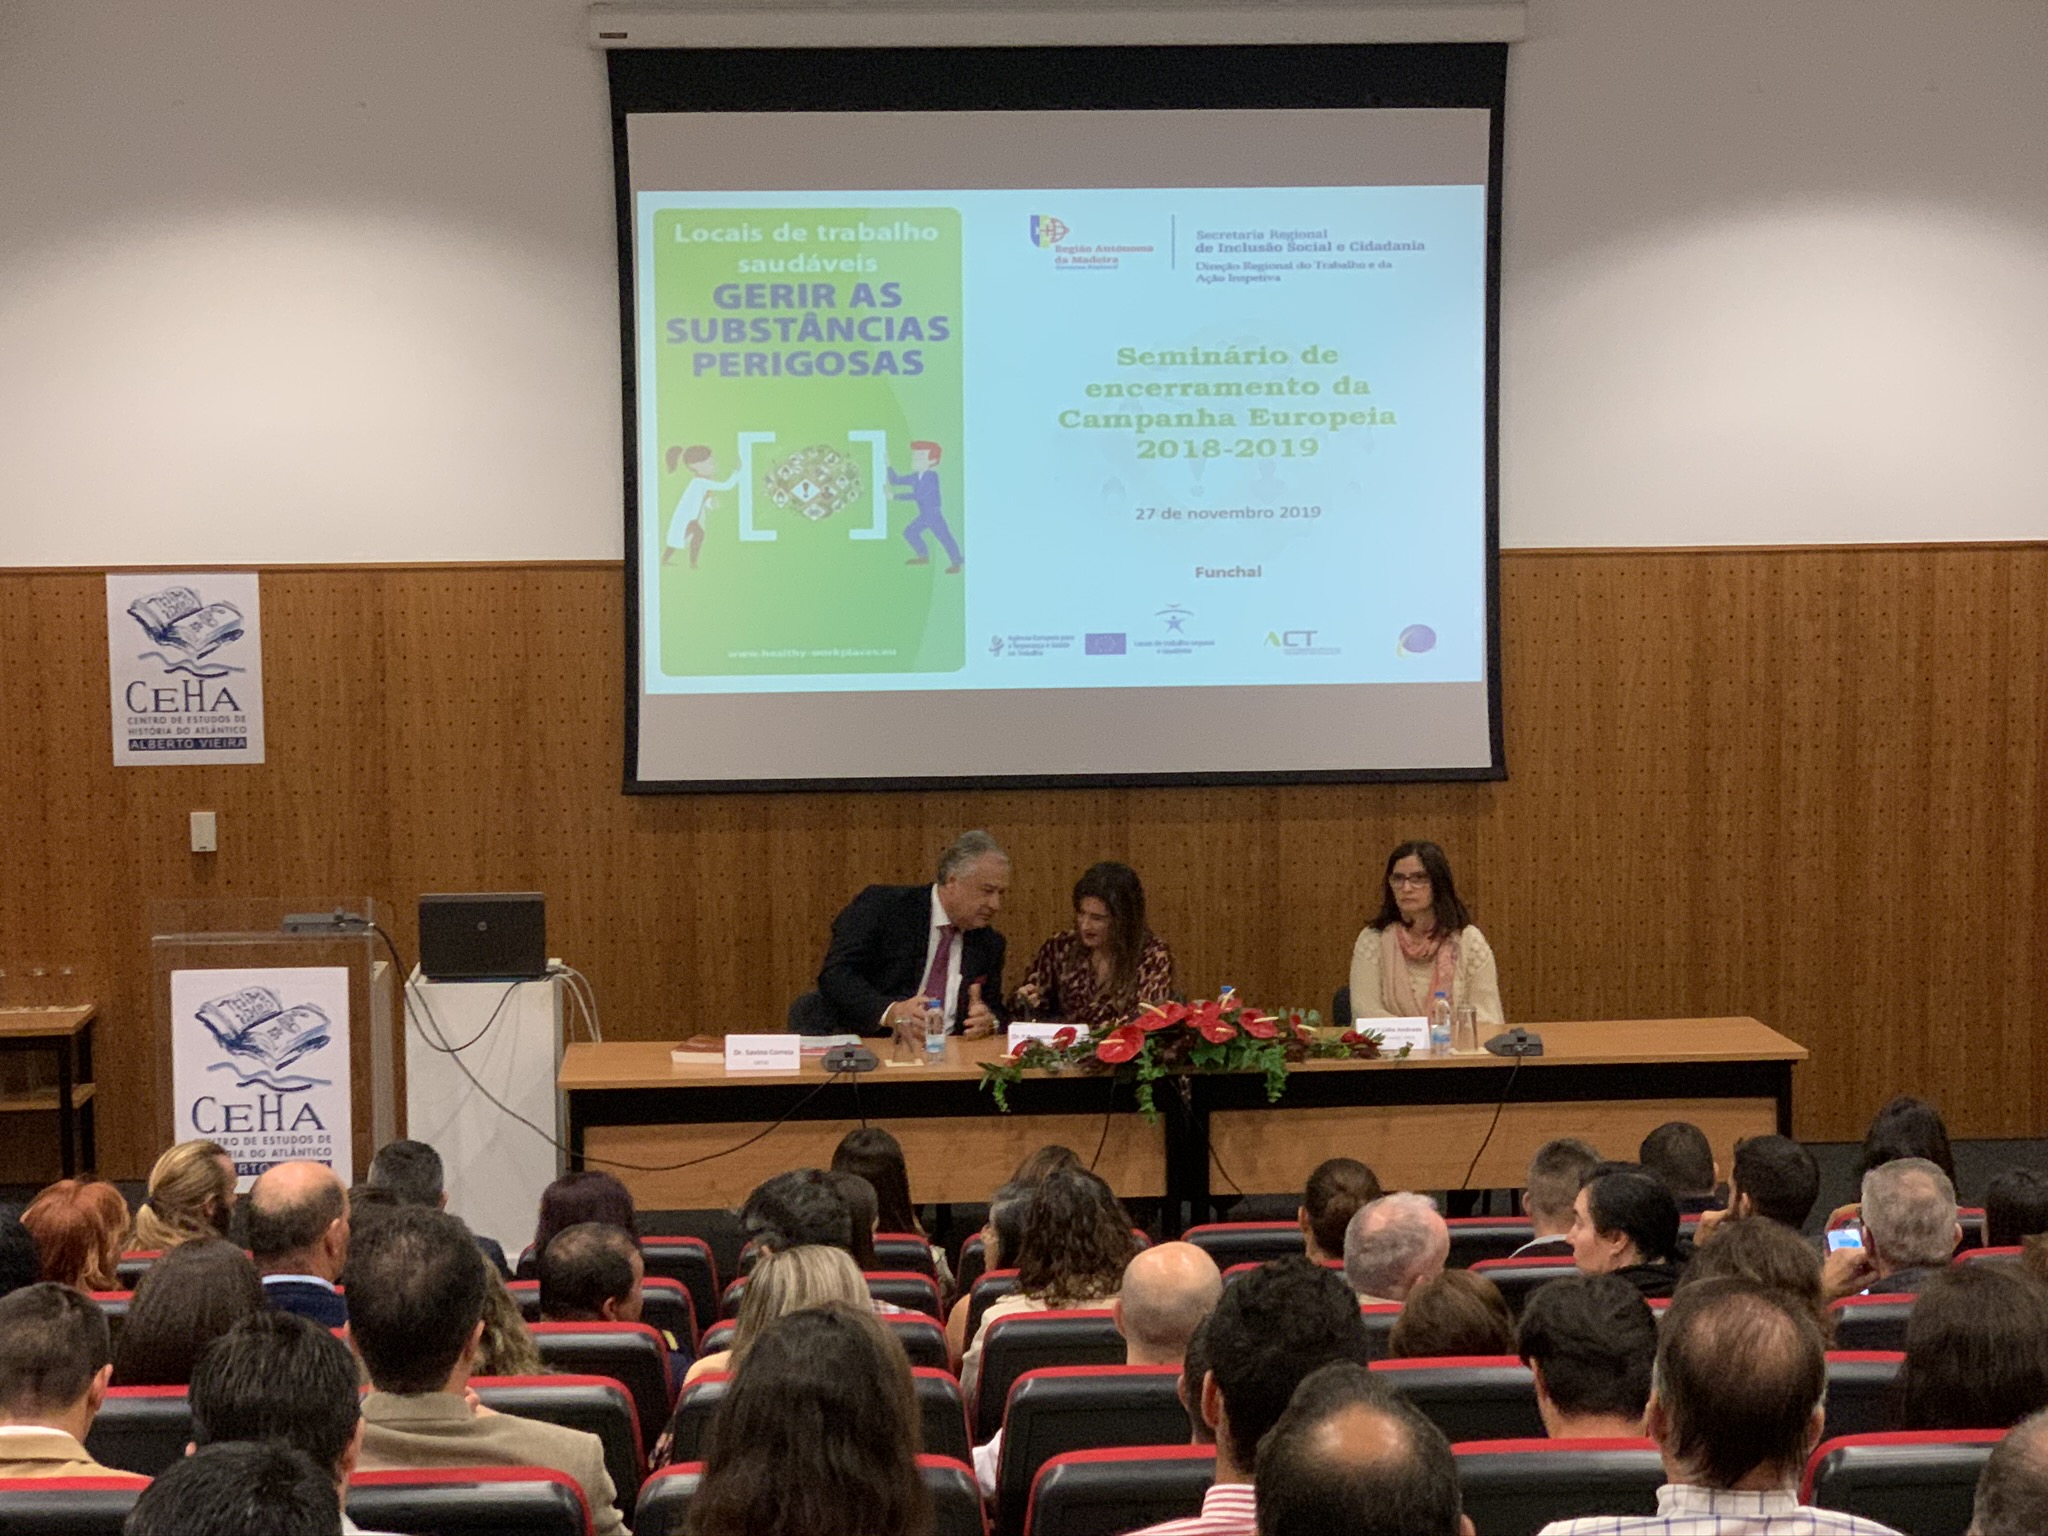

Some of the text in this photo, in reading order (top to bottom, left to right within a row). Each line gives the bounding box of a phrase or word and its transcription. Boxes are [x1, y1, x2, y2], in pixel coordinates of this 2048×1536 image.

[674, 221, 939, 243] Locais de trabalho
[1196, 229, 1328, 241] Secretaria Regional
[1195, 240, 1425, 253] de Inclusão Social e Cidadania
[737, 253, 878, 273] saudáveis
[713, 282, 903, 310] GERIR AS
[666, 311, 950, 344] SUBSTÂNCIAS
[693, 350, 925, 378] PERIGOSAS
[1117, 345, 1339, 367] Seminário de
[1085, 376, 1371, 397] encerramento da
[1058, 406, 1397, 433] Campanha Europeia
[1136, 438, 1320, 459] 2018-2019
[1135, 506, 1321, 520] 27 de novembro 2019
[1195, 566, 1262, 579] Funchal
[1263, 630, 1319, 647] ACT
[127, 715, 246, 725] CENTRO DE ESTUDOS DE
[128, 725, 247, 735] HISTÓRIA DO ATLÂNTICO
[130, 738, 246, 749] ALBERTO VIEIRA
[243, 1136, 257, 1146] DE
[263, 1135, 313, 1145] ESTUDOS
[318, 1135, 331, 1143] DE
[250, 1149, 266, 1158] DO
[272, 1146, 332, 1157] ATLÂNTICO
